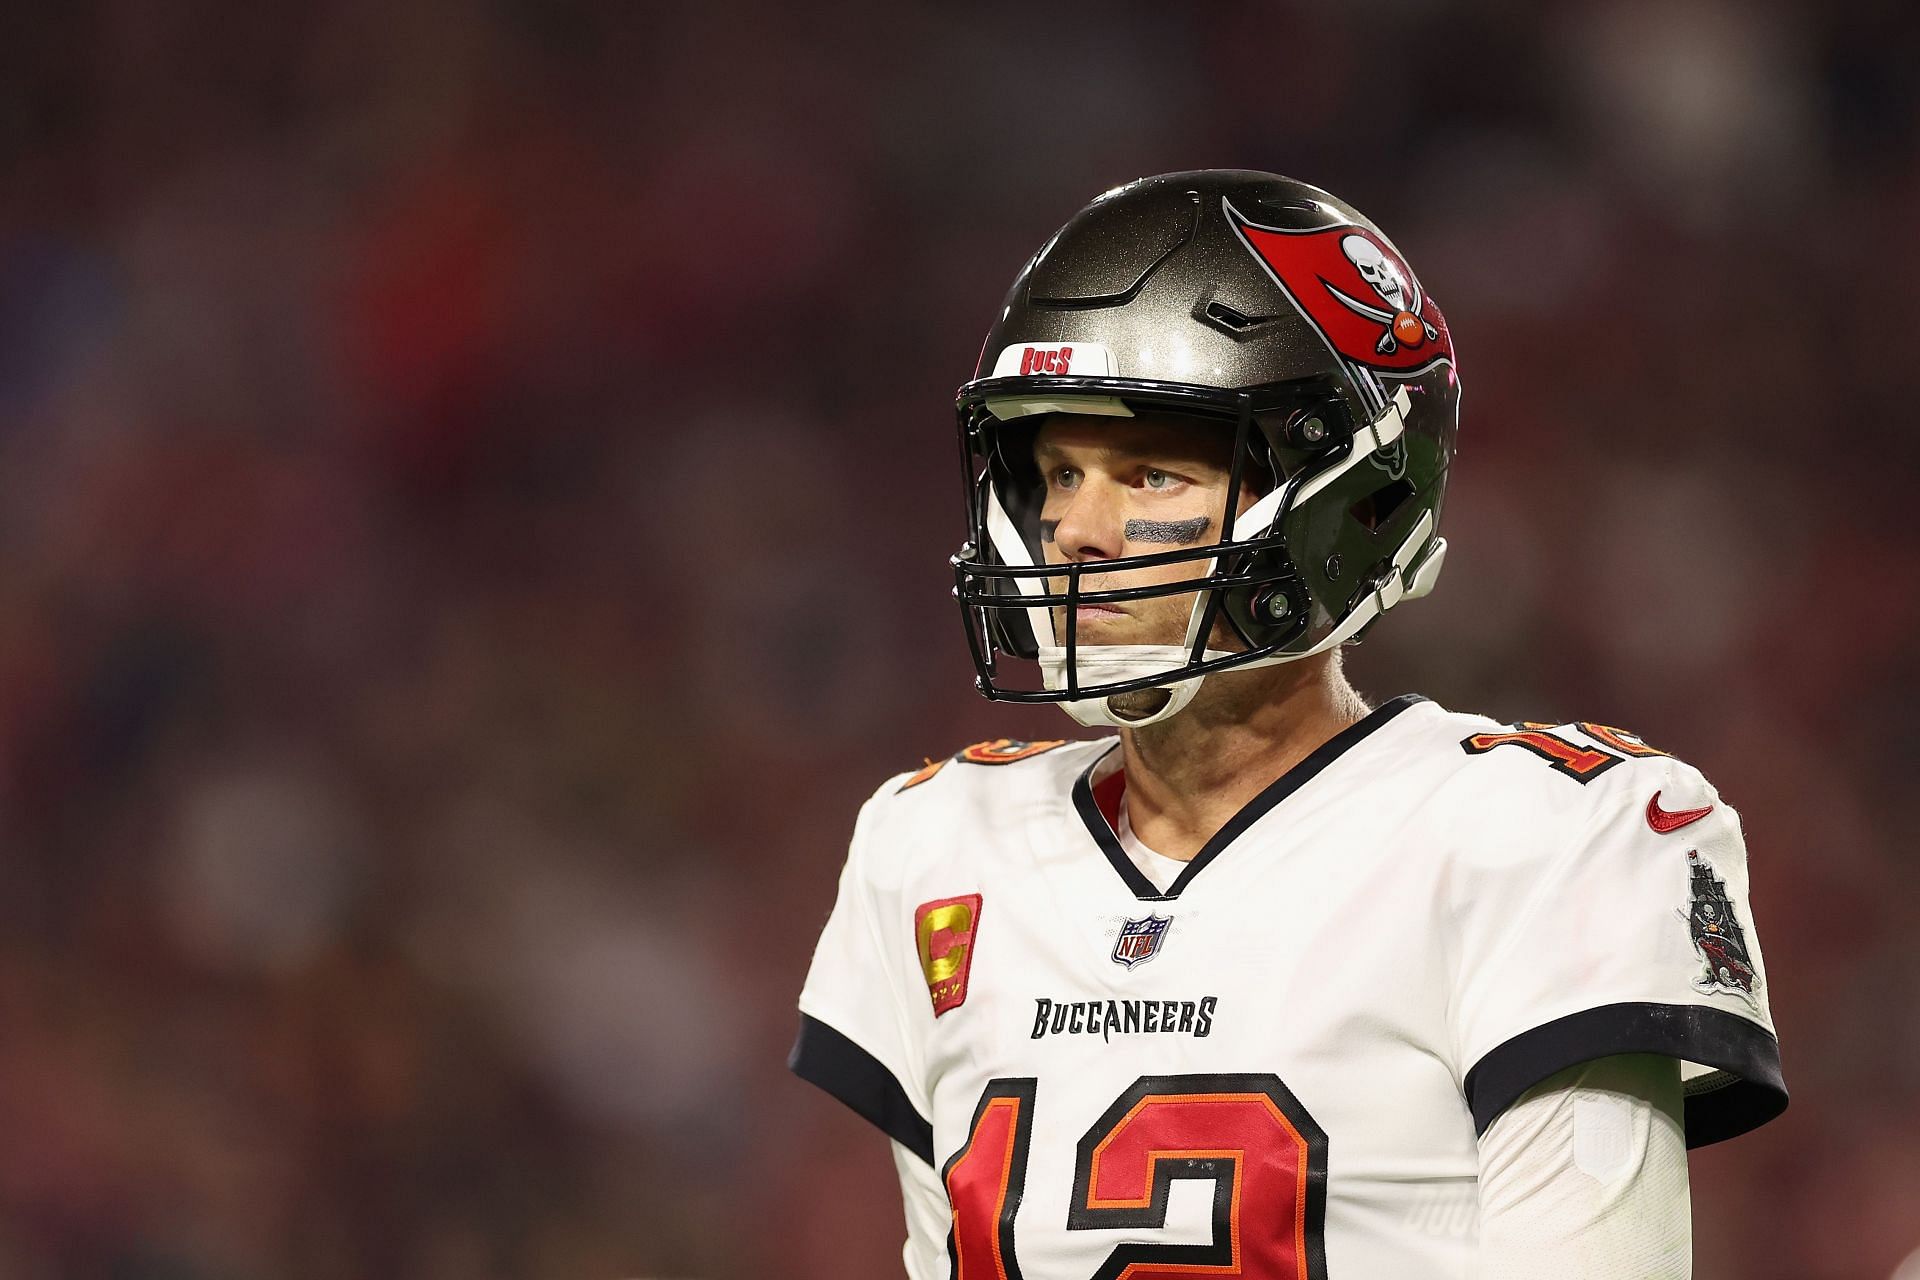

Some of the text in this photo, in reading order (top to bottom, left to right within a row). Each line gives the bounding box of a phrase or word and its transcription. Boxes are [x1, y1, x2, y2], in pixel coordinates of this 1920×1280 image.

[1019, 346, 1073, 376] BUCS
[920, 903, 972, 986] C
[1118, 934, 1153, 959] NFL
[1030, 996, 1218, 1045] BUCCANEERS
